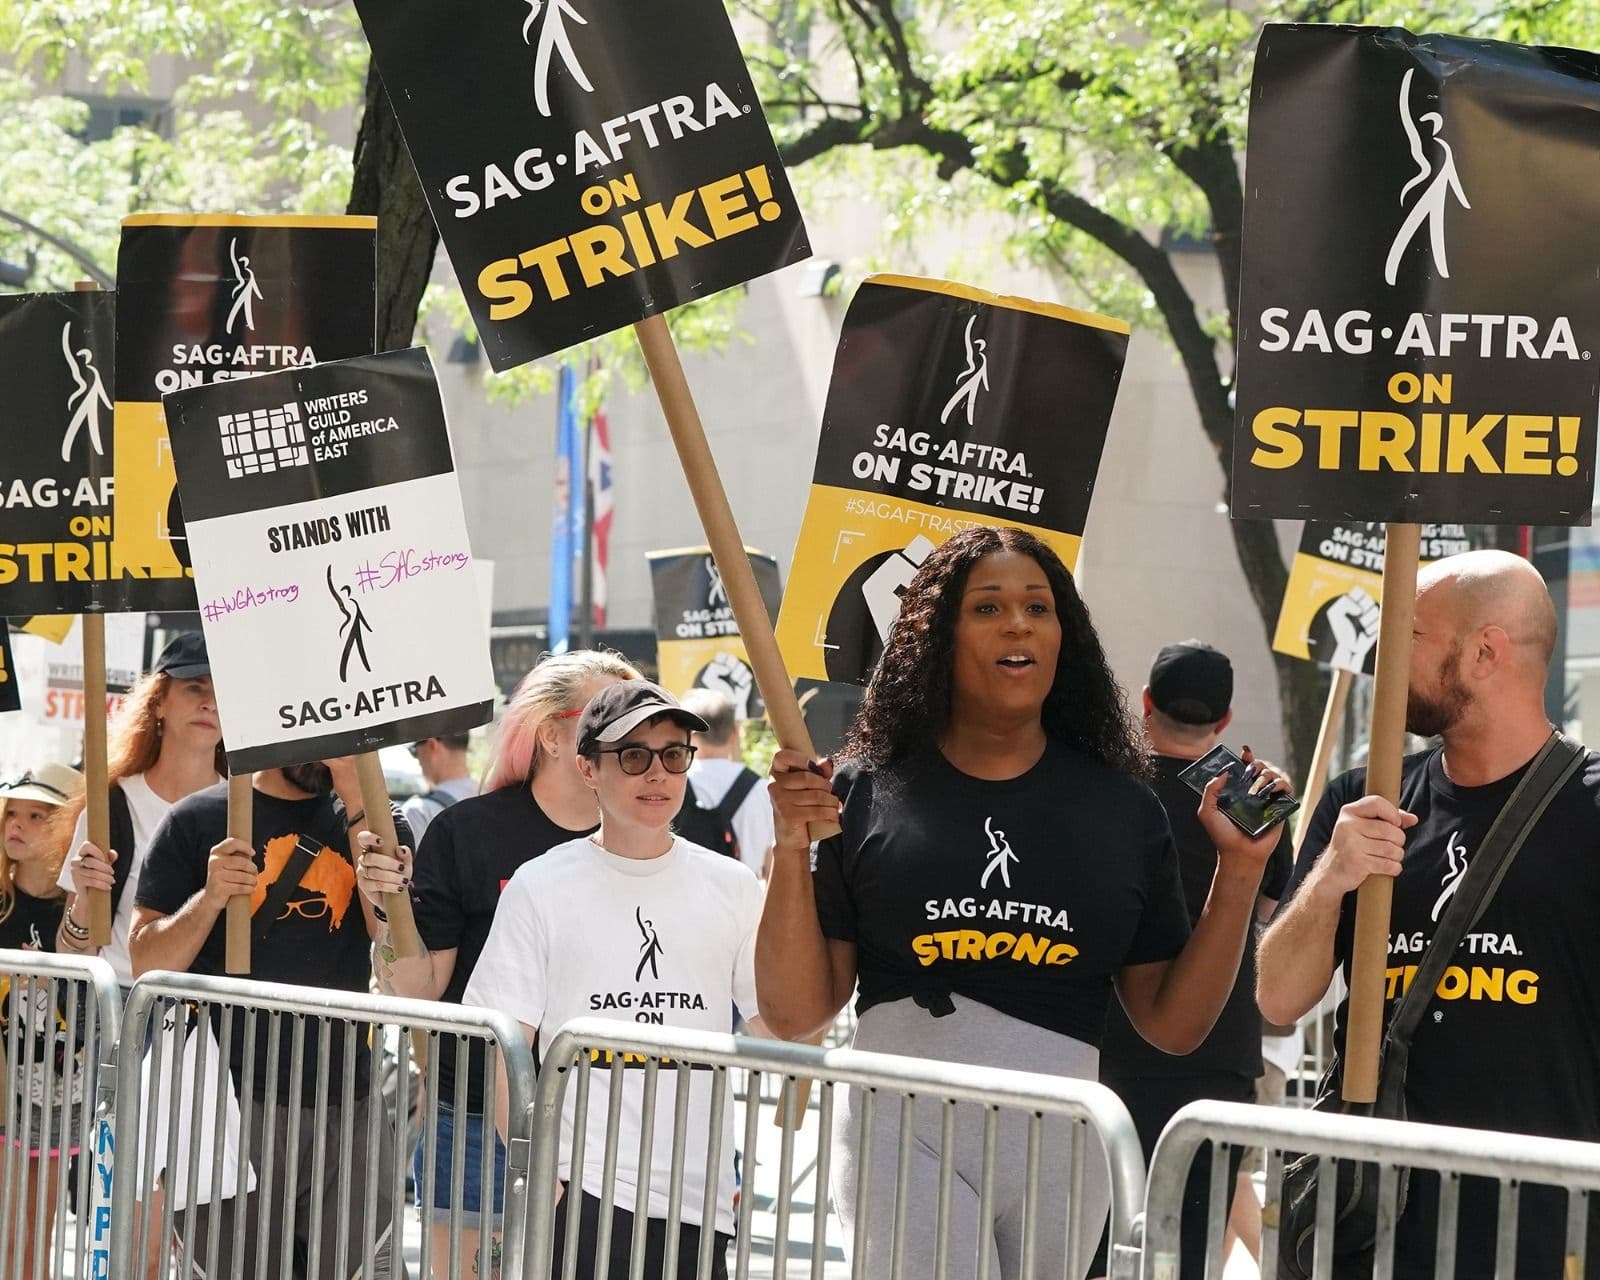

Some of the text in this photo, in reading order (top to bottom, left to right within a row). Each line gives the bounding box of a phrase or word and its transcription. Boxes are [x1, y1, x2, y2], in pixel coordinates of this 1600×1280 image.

[581, 174, 640, 215] ON
[477, 164, 781, 320] STRIKE!
[173, 345, 317, 366] SAG·AFTRA
[155, 369, 203, 393] ON
[1387, 372, 1452, 404] ON
[304, 390, 368, 414] WRITERS
[308, 410, 350, 430] GUILD
[312, 417, 399, 447] of AMERICA
[314, 442, 349, 462] EAST
[1250, 407, 1580, 477] STRIKE!
[852, 452, 1044, 514] ON STRIKE!
[69, 516, 111, 537] ON
[268, 505, 391, 553] STANDS WITH
[1319, 539, 1349, 561] ON
[355, 548, 469, 594] #SAGstrong
[676, 623, 703, 638] ON
[278, 675, 447, 729] SAG·AFTRA
[912, 929, 1079, 966] STRONG
[635, 1011, 664, 1025] ON
